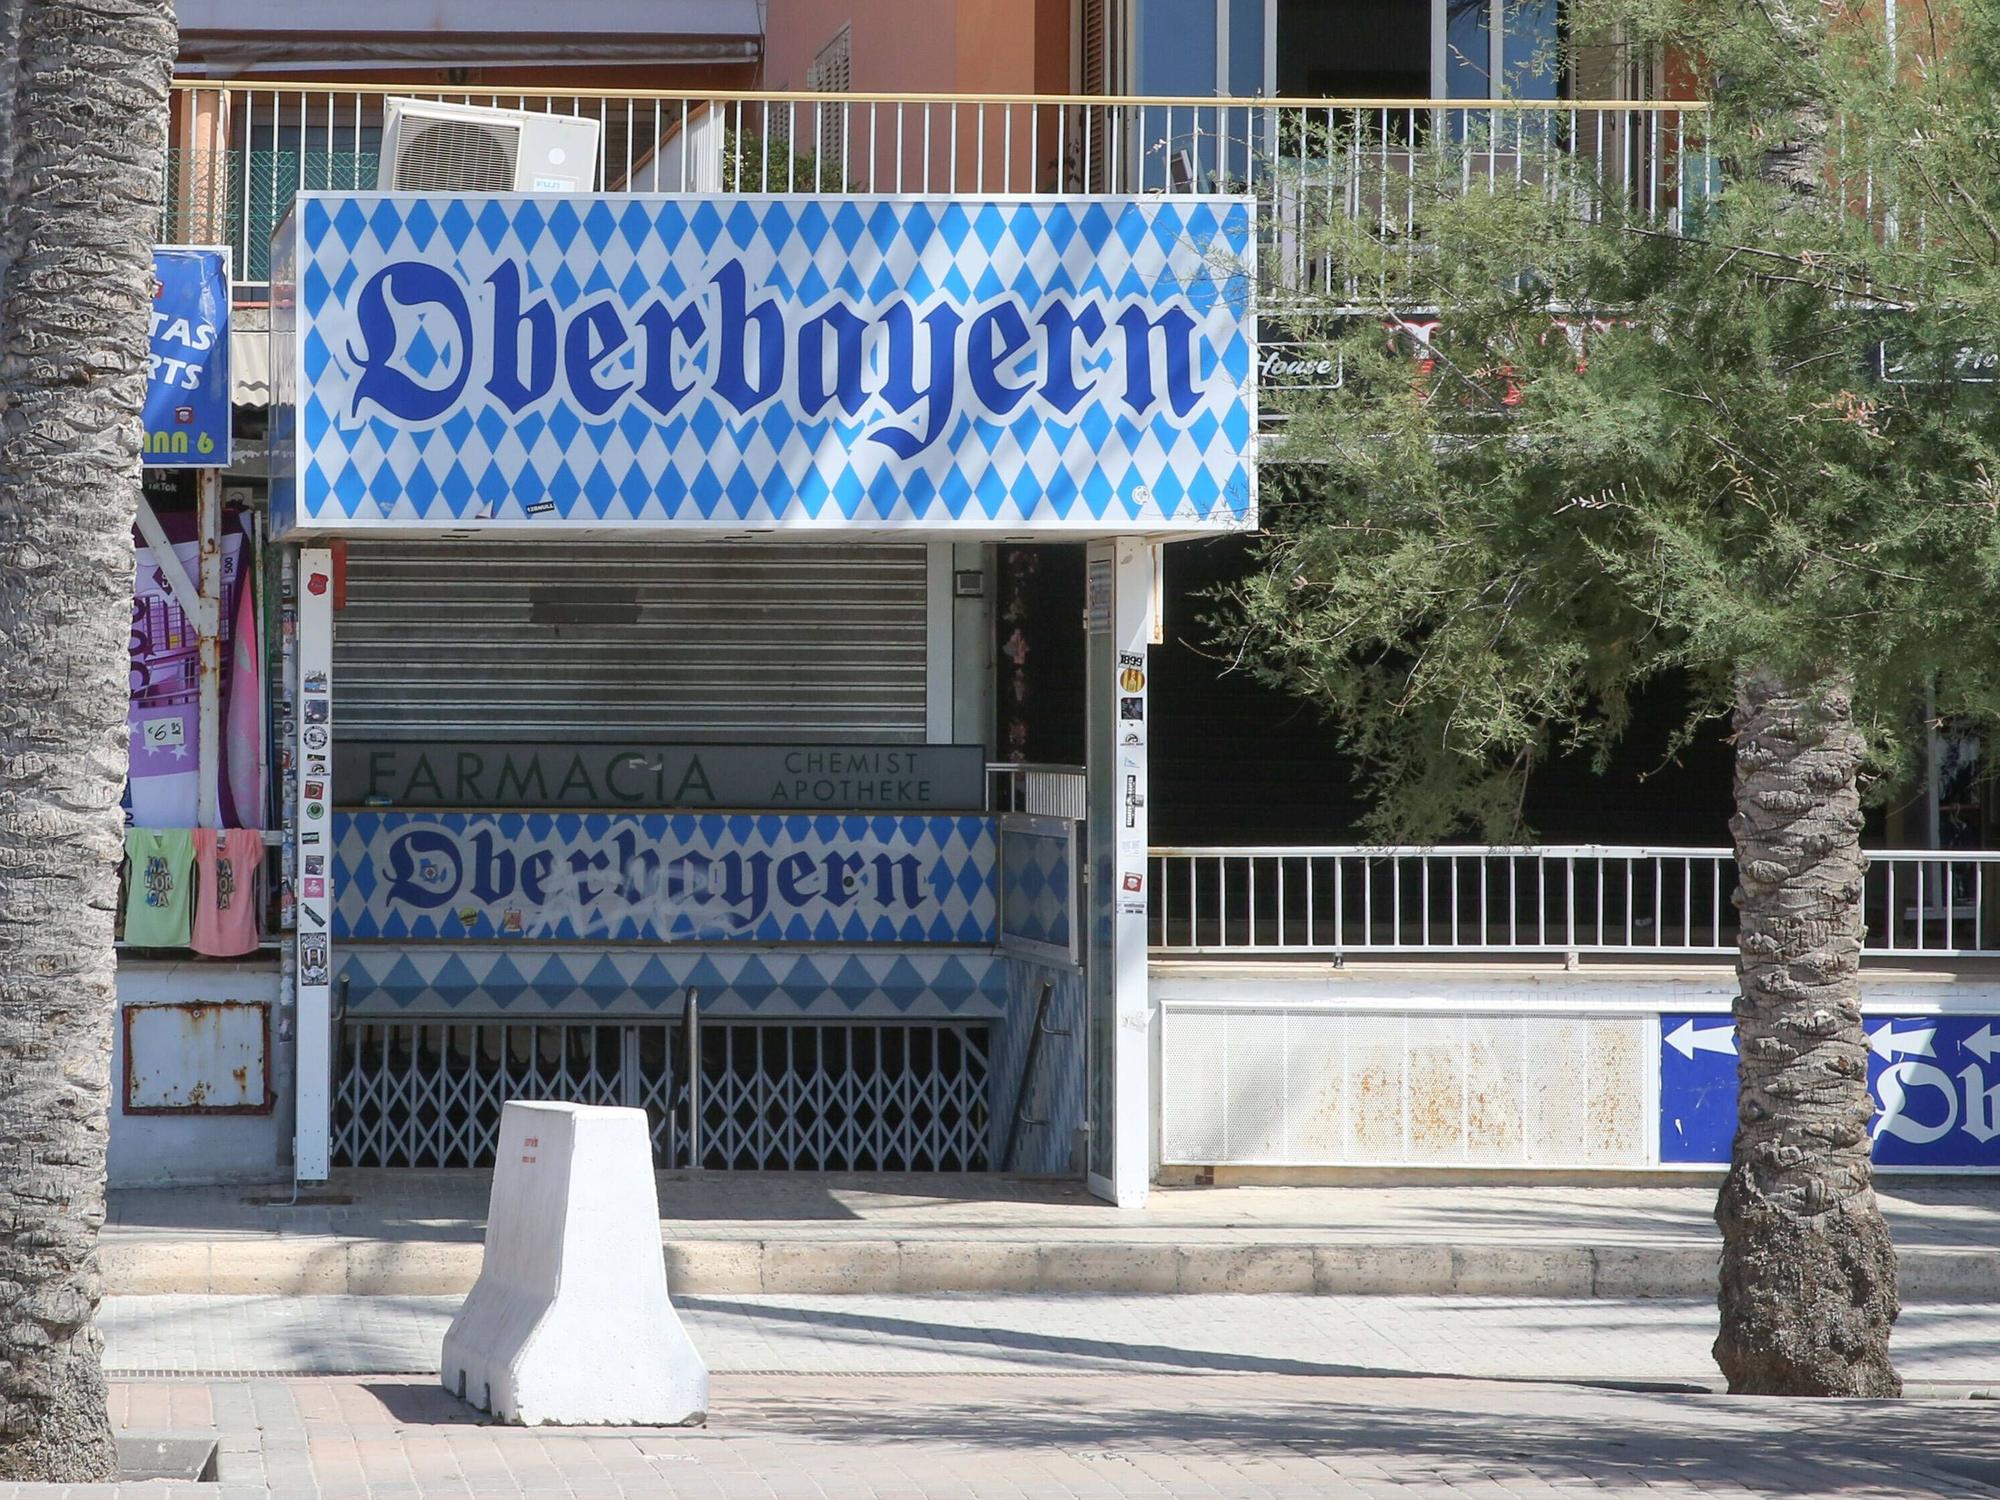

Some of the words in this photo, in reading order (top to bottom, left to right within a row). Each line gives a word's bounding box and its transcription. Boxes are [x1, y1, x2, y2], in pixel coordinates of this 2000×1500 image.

[146, 311, 213, 351] TAS
[146, 352, 203, 390] RTS
[346, 257, 1206, 461] Oberbayern
[197, 431, 214, 454] 6
[1120, 655, 1143, 667] 1899
[369, 751, 716, 801] FARMACIA
[784, 752, 919, 774] CHEMIST
[771, 779, 931, 801] APOTHEKE
[382, 828, 928, 928] Oberbayern
